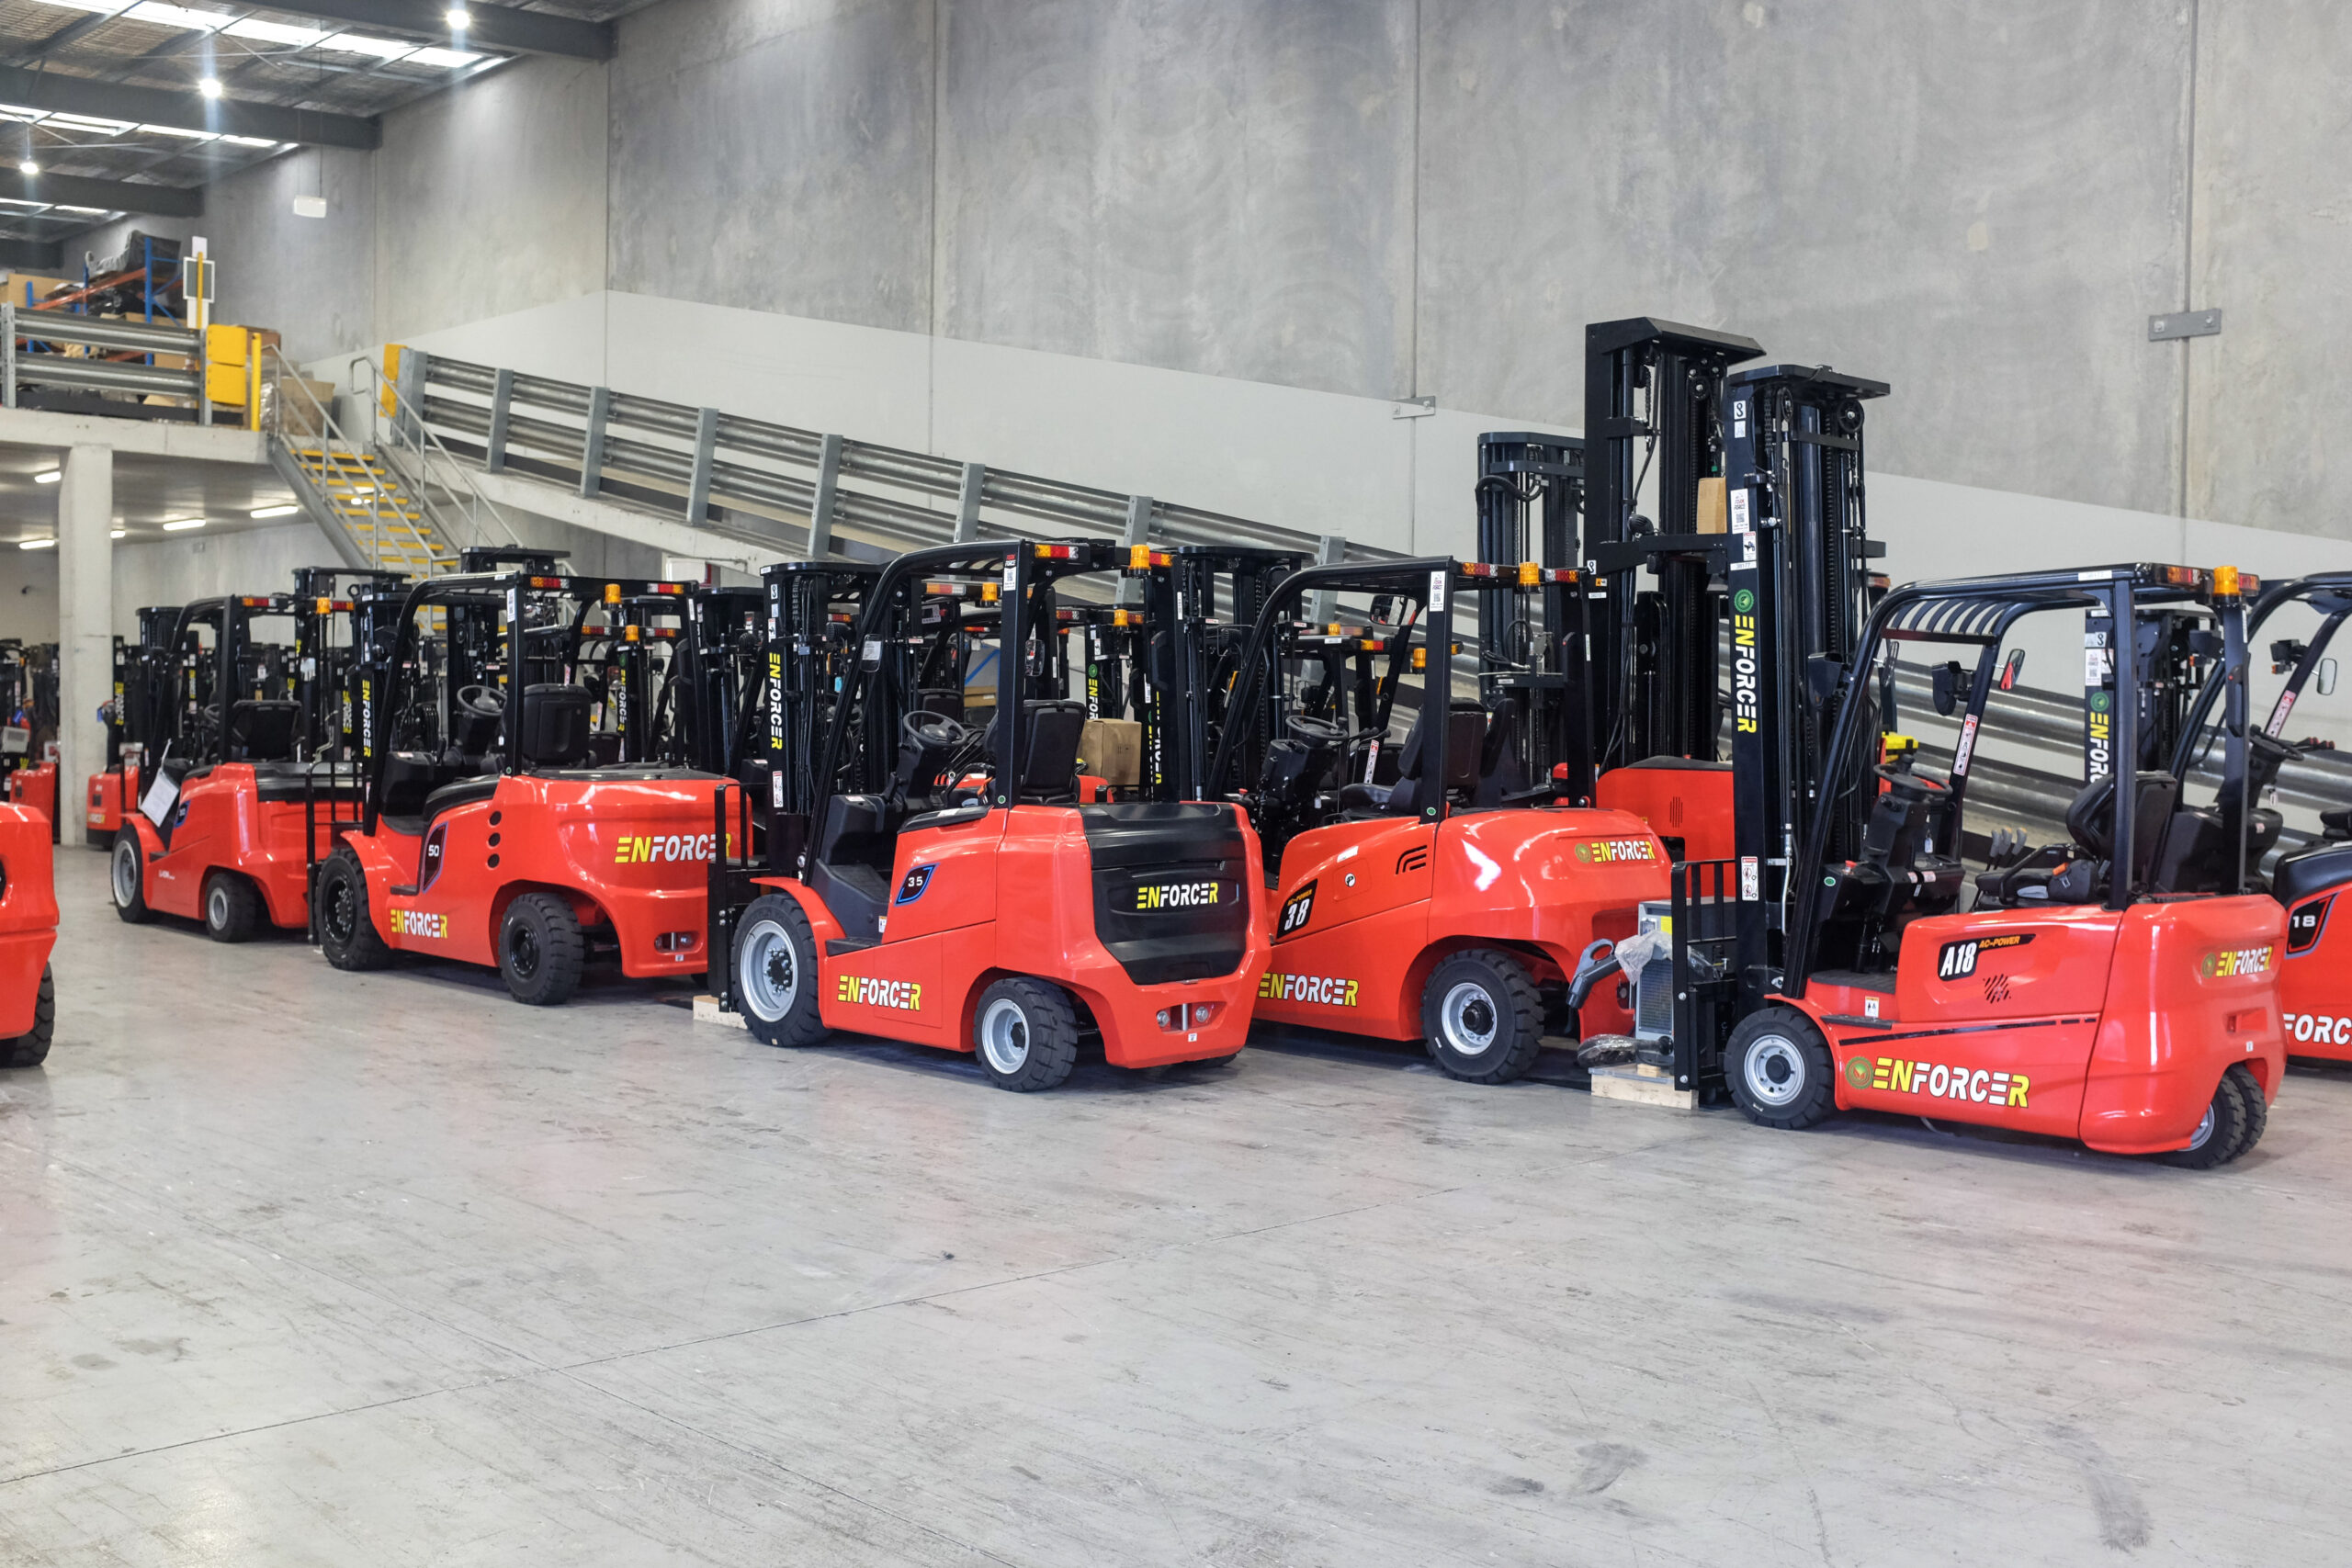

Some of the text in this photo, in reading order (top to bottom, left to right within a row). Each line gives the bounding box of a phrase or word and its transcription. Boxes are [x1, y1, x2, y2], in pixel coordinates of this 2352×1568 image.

[1735, 615, 1757, 734] ENFORCER
[769, 651, 783, 750] ENFORCER
[362, 679, 372, 758] ENFORCER
[427, 844, 440, 857] 50
[1591, 840, 1656, 863] ENFORCER
[908, 875, 923, 887] 35
[1136, 882, 1219, 909] ENFORCER
[390, 908, 448, 939] ENFORCER
[1283, 897, 1310, 931] 38
[2292, 915, 2316, 929] 18
[1978, 935, 2021, 949] AC-POWER
[1939, 942, 1978, 977] A18
[2215, 945, 2273, 977] ENFORCER
[837, 974, 922, 1011] ENFORCER
[1259, 972, 1360, 1008] ENFORCER
[1871, 1056, 2030, 1109] ENFORCER
